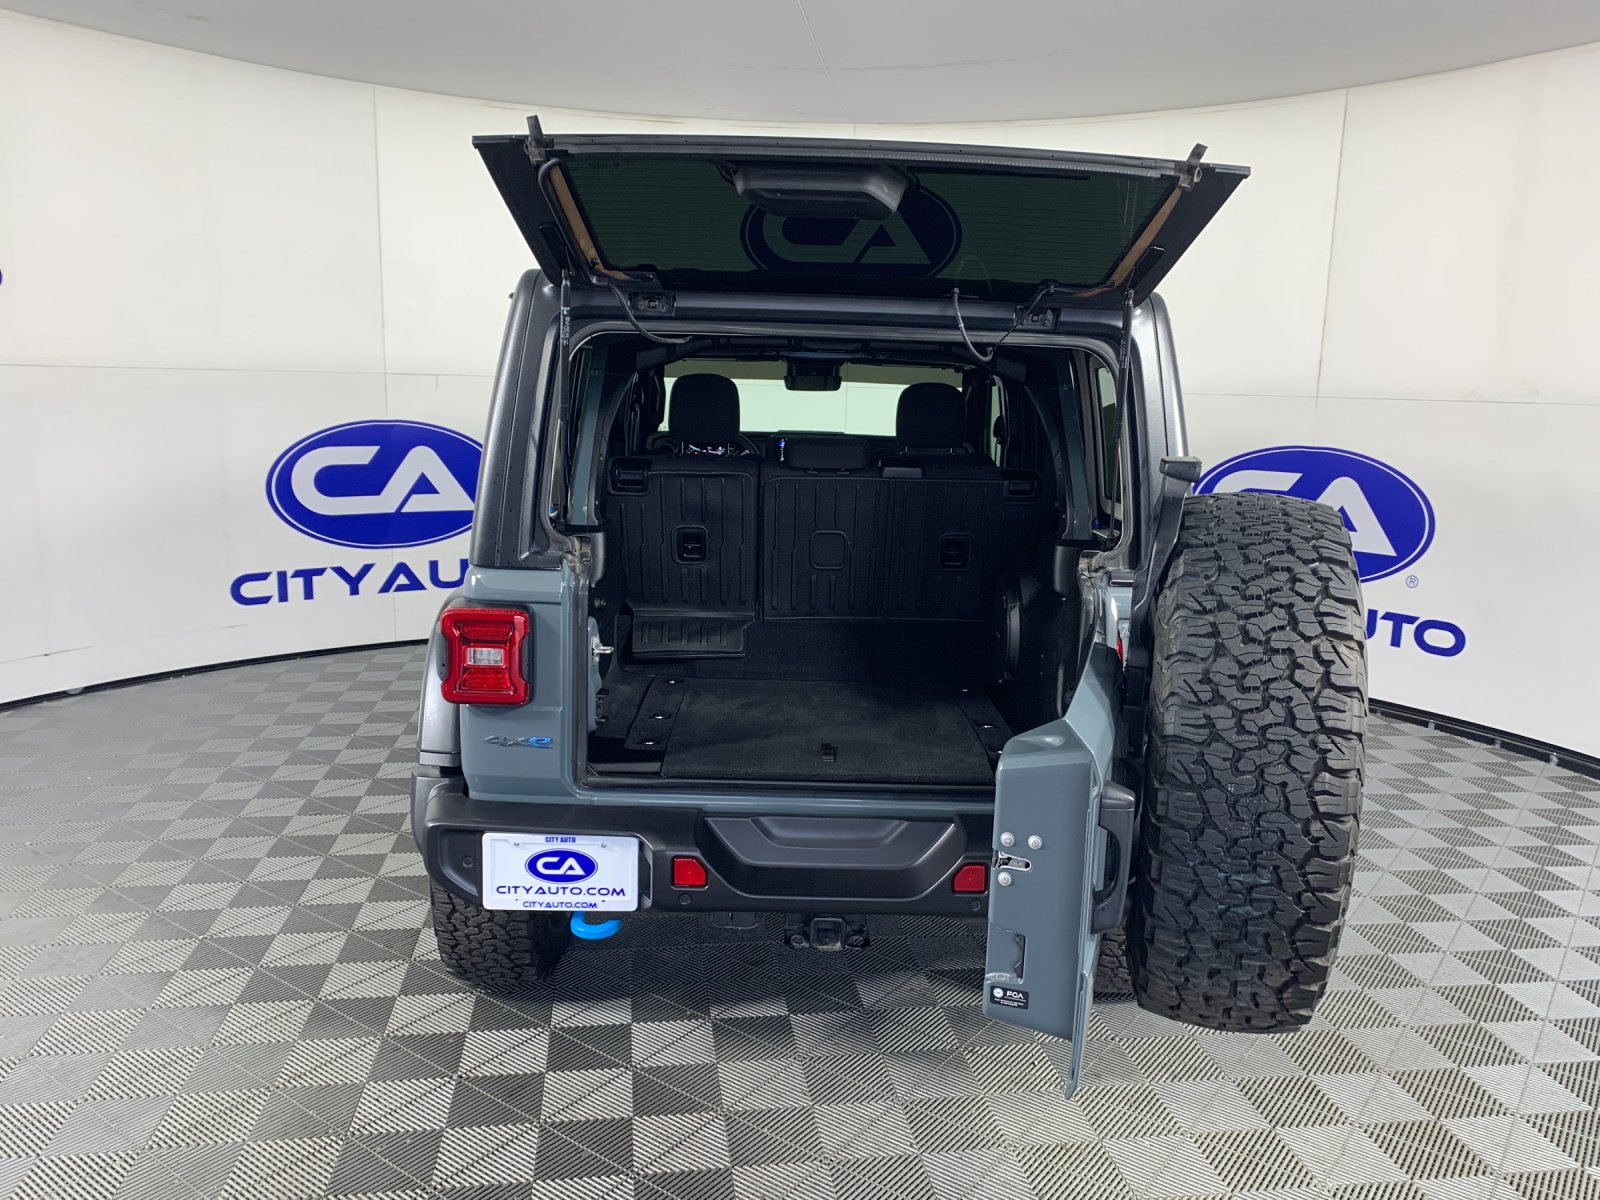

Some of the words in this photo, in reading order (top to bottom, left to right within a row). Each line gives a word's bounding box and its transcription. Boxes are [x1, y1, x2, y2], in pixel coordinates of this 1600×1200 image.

[291, 445, 476, 516] CA
[536, 856, 586, 876] CA
[496, 885, 626, 897] CITYAUTO.COM
[522, 901, 598, 909] CITYAUTO.COM
